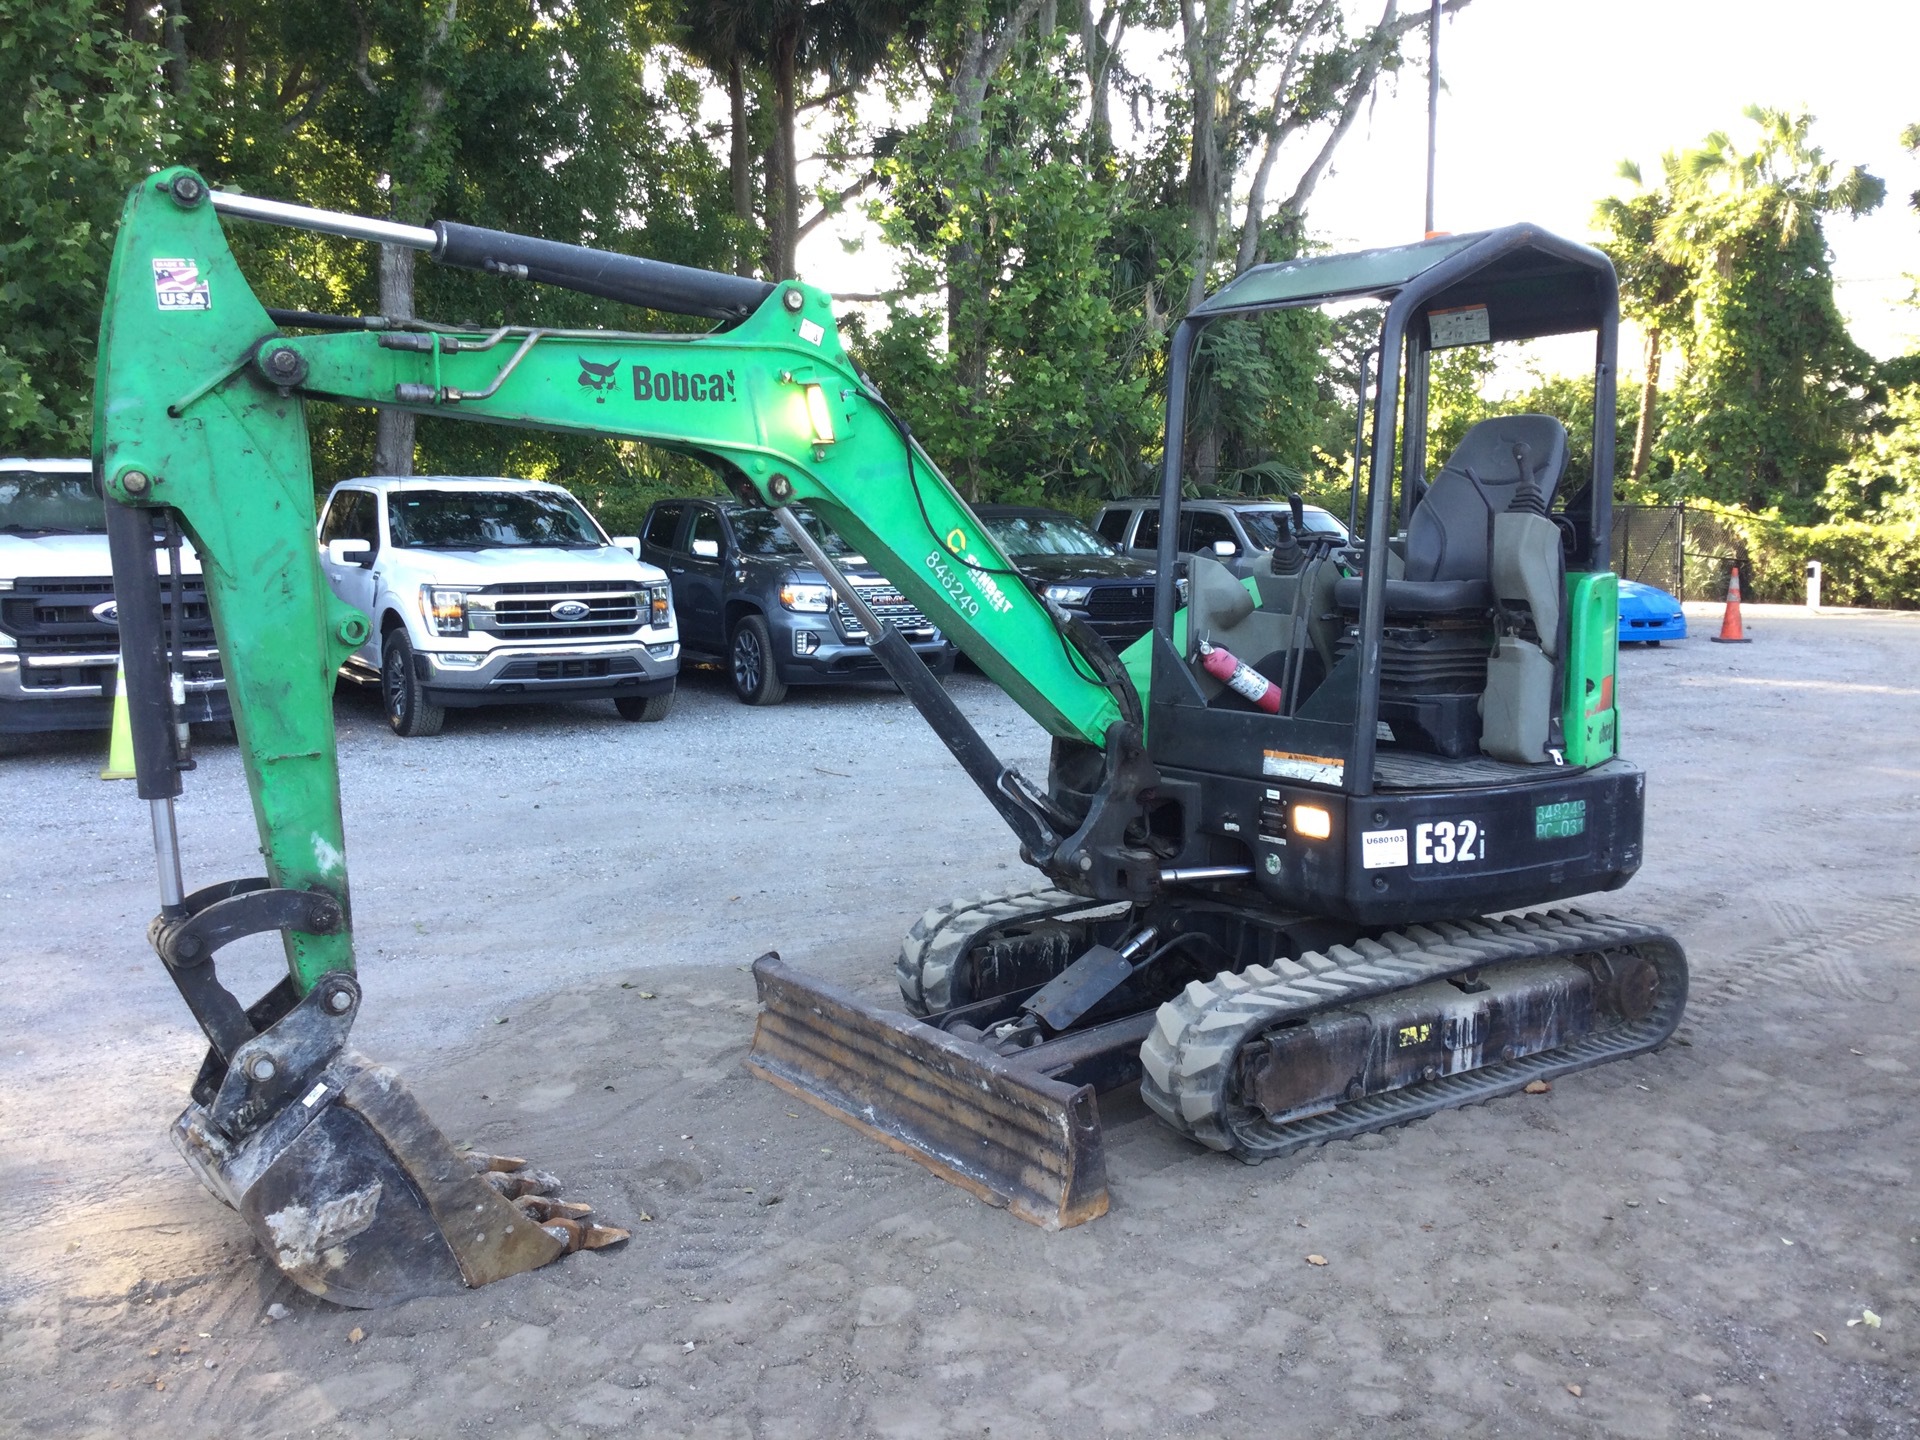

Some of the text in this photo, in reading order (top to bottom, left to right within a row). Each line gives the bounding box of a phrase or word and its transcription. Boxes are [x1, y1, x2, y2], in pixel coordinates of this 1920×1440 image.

[160, 292, 207, 305] USA
[925, 550, 979, 617] 848249
[1366, 835, 1405, 845] U680103
